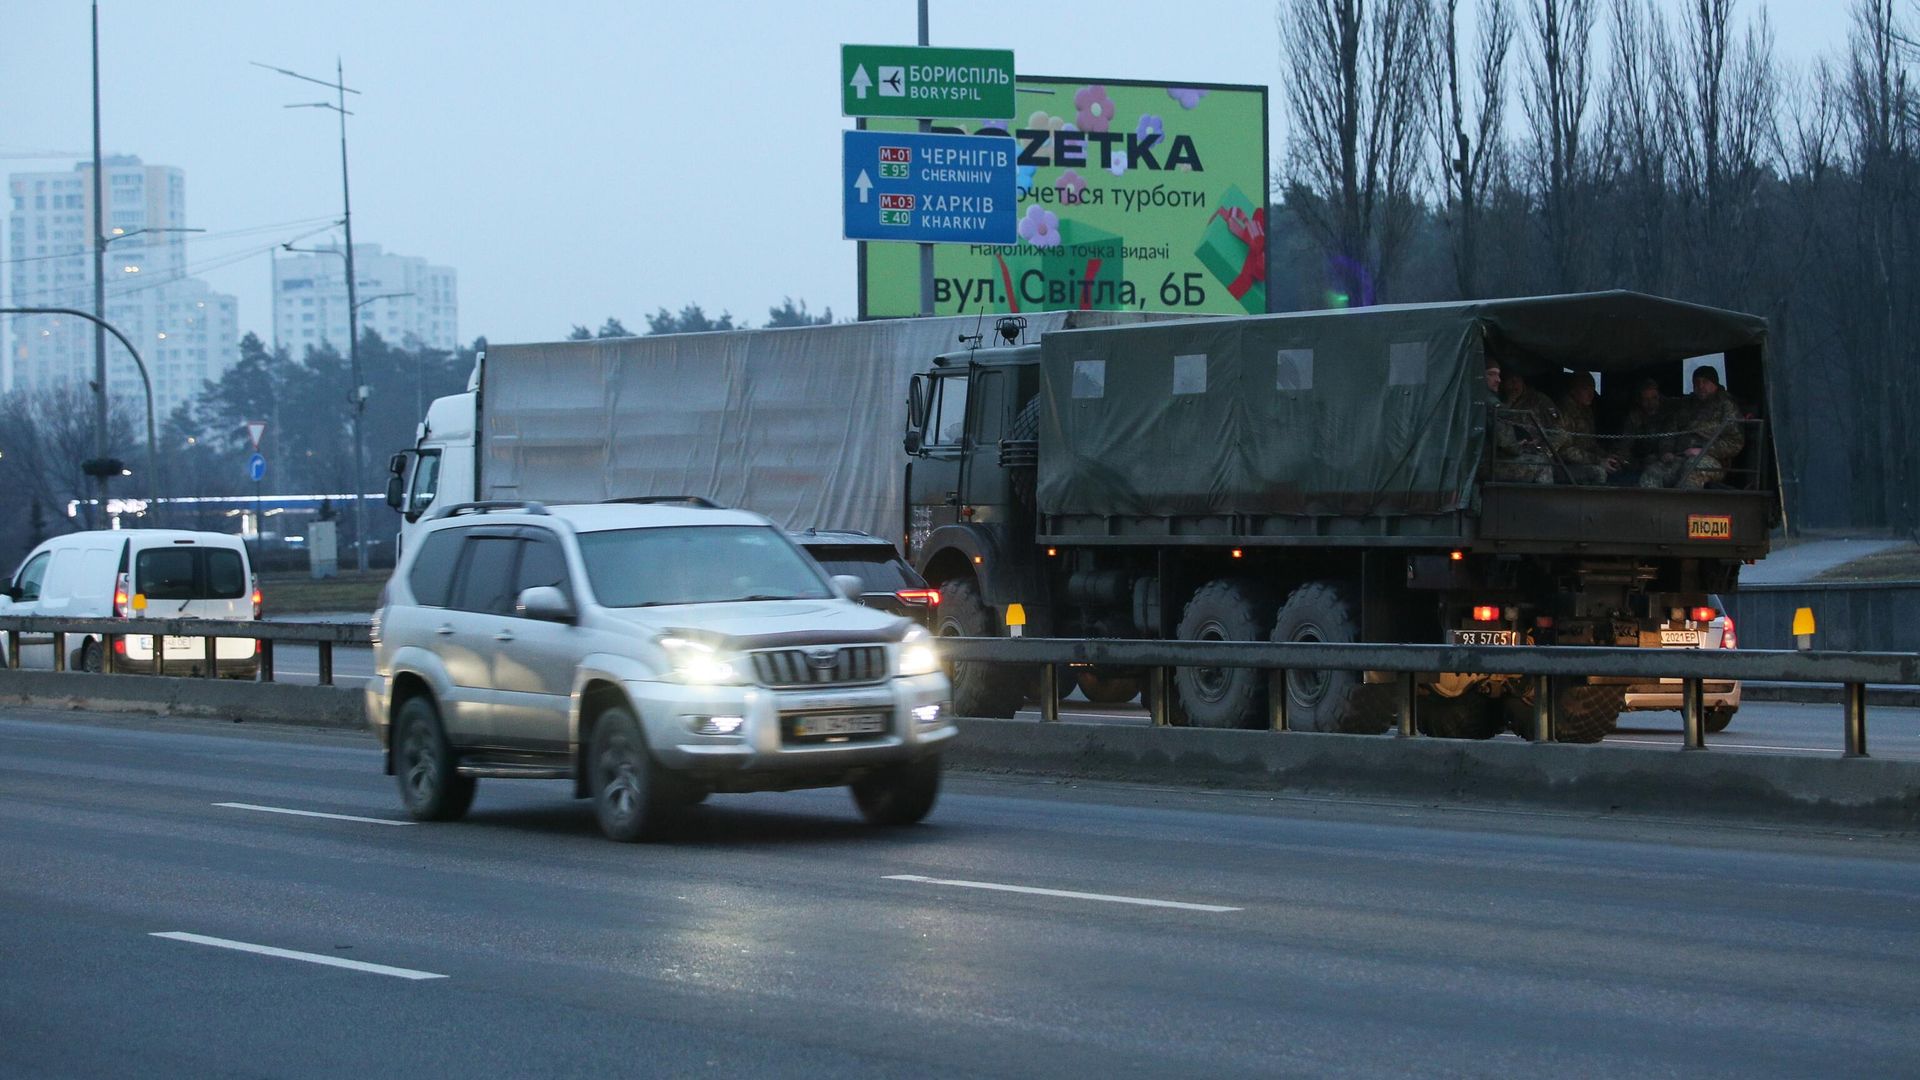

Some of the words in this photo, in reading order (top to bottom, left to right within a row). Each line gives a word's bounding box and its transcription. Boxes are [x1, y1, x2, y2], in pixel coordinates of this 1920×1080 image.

[910, 65, 1009, 85] БОРИСПІЛЬ
[910, 86, 981, 100] BORYSPIL
[881, 149, 911, 162] M-01
[930, 126, 1204, 172] ZETKA
[921, 148, 1008, 168] ЧЕРНІГІВ
[881, 164, 887, 176] E
[892, 164, 908, 177] 95
[921, 168, 992, 184] CHERNIHIV
[881, 196, 913, 208] M-03
[922, 195, 994, 213] ХАРКІВ
[1111, 184, 1206, 212] турботи
[881, 211, 887, 223] E
[892, 211, 909, 223] 40
[921, 215, 987, 230] KHARKIV
[1072, 245, 1115, 258] точка
[1121, 242, 1169, 261] видачі
[934, 277, 1006, 313] вул.
[1020, 269, 1146, 310] Світла,
[1159, 271, 1206, 307] 6Б
[1691, 521, 1728, 536] ЛЮДИ
